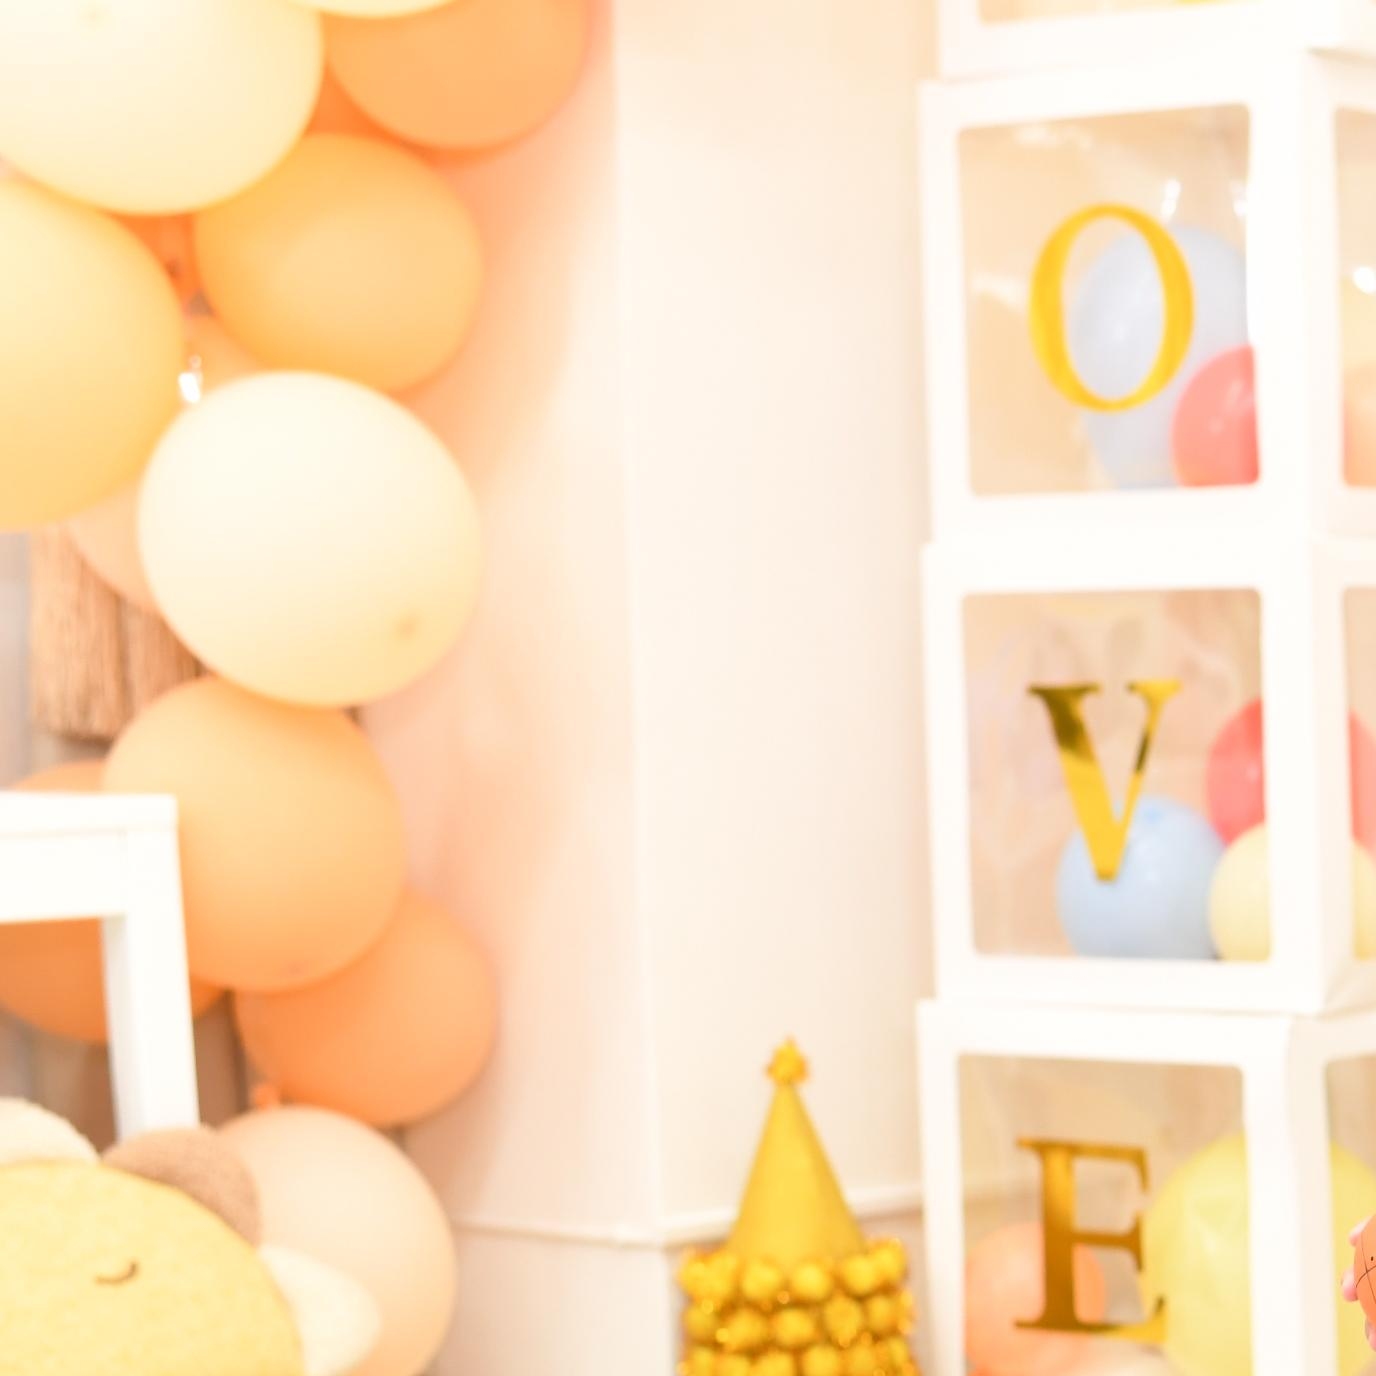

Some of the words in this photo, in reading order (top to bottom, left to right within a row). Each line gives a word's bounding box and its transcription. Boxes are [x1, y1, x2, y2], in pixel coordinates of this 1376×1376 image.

[1027, 203, 1194, 413] O
[1026, 678, 1183, 883] V
[1012, 1136, 1168, 1344] E
